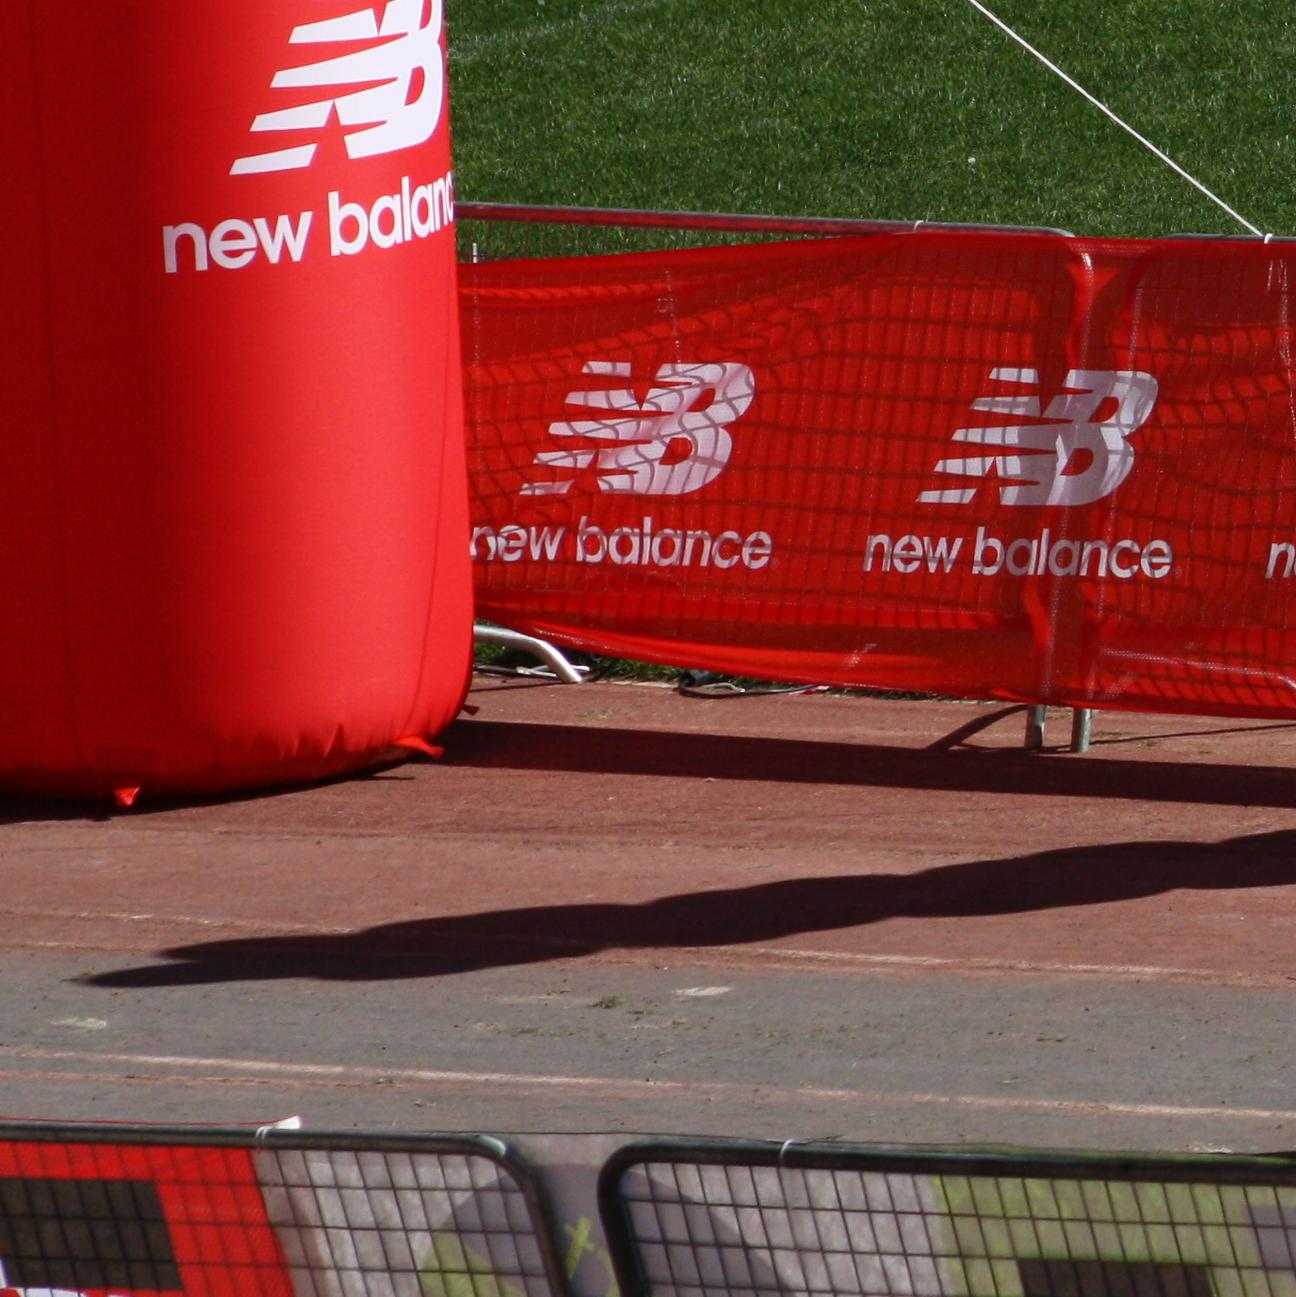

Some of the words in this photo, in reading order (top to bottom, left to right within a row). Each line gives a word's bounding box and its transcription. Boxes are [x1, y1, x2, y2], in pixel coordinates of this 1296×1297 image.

[163, 210, 312, 273] new
[328, 171, 454, 256] balanc
[469, 525, 564, 561] new
[576, 516, 771, 569] balance
[864, 535, 962, 574] new
[972, 527, 1172, 578] balance
